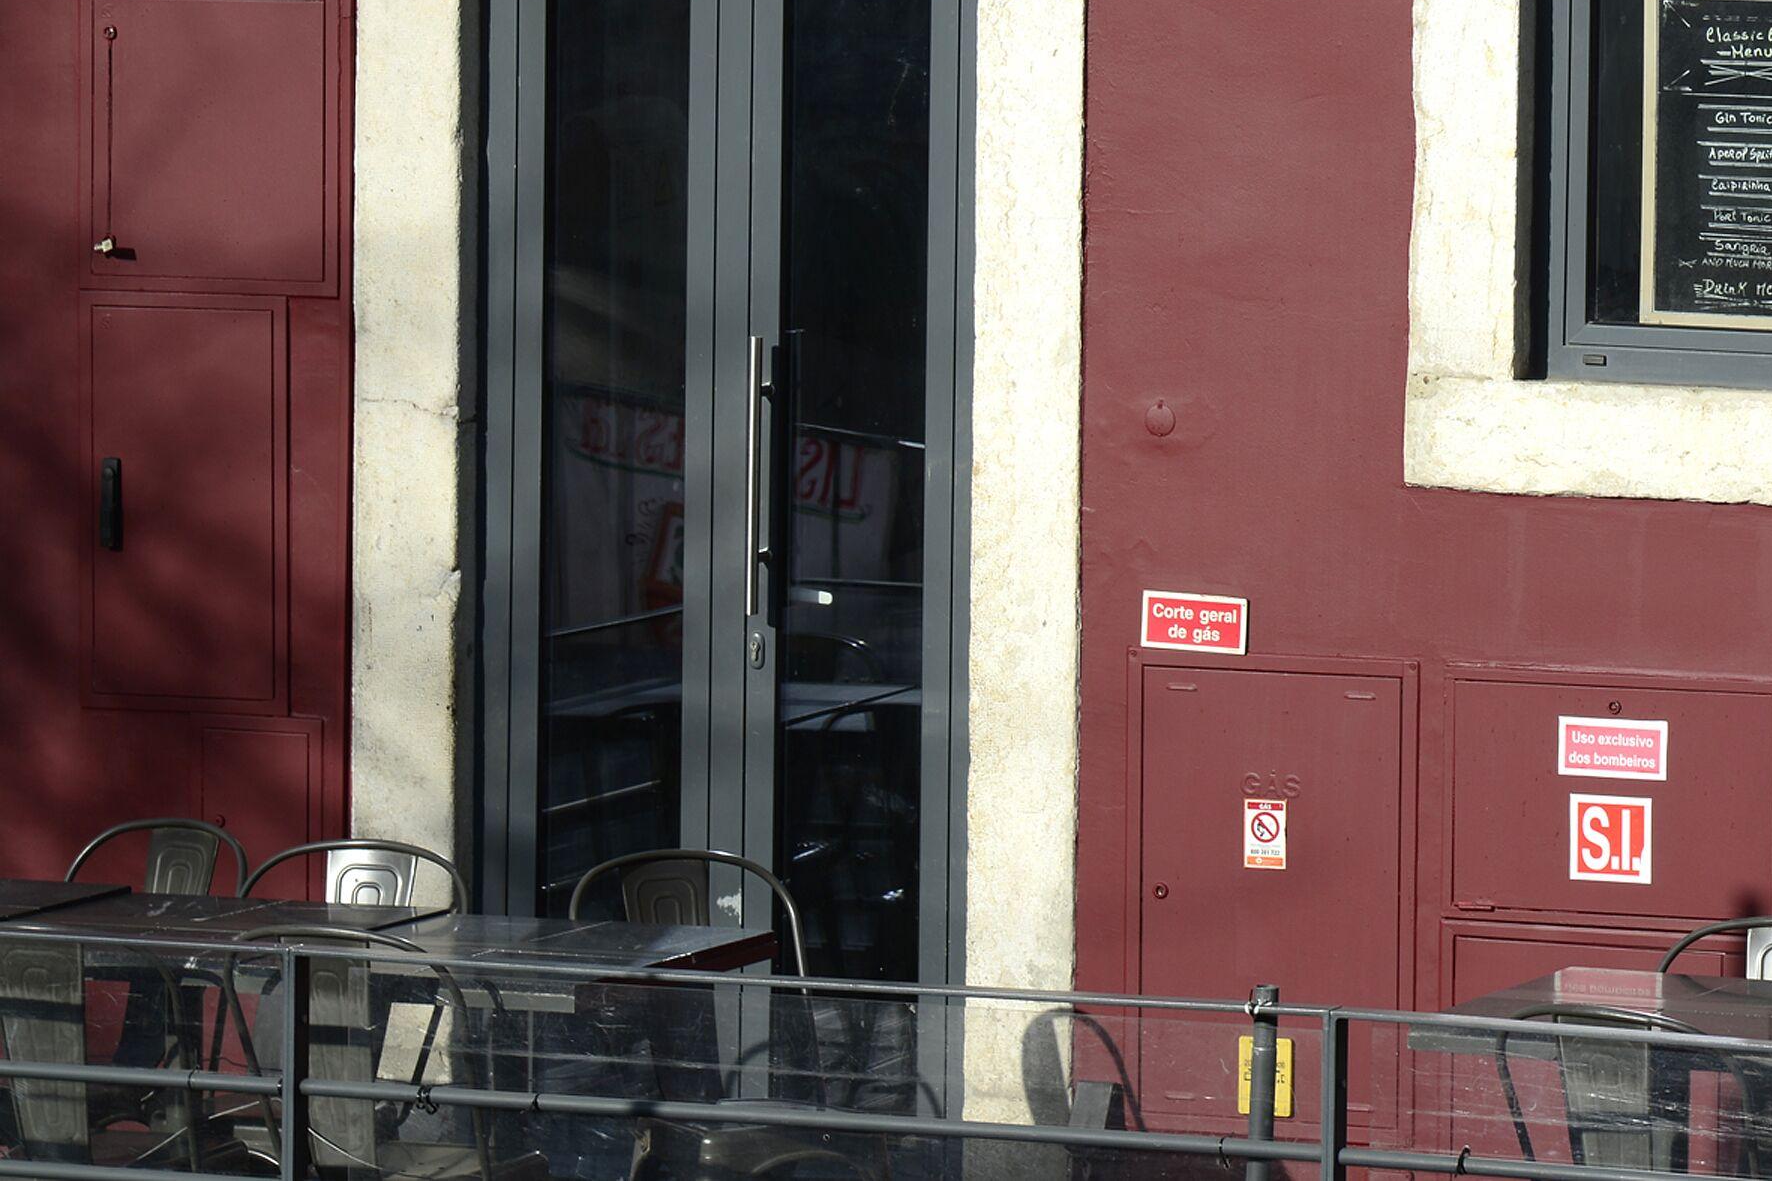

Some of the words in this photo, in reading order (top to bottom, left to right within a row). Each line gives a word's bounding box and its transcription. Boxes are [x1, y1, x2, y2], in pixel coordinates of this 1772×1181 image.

[1706, 26, 1764, 43] Classic
[1715, 111, 1737, 124] Gin
[1152, 603, 1194, 620] Corte
[1199, 609, 1237, 625] geral
[1168, 624, 1187, 639] de
[1192, 626, 1221, 644] gás
[1571, 730, 1595, 744] Uso
[1598, 731, 1654, 748] exclusivo
[1568, 750, 1590, 765] dos
[1594, 752, 1656, 769] bombeiros
